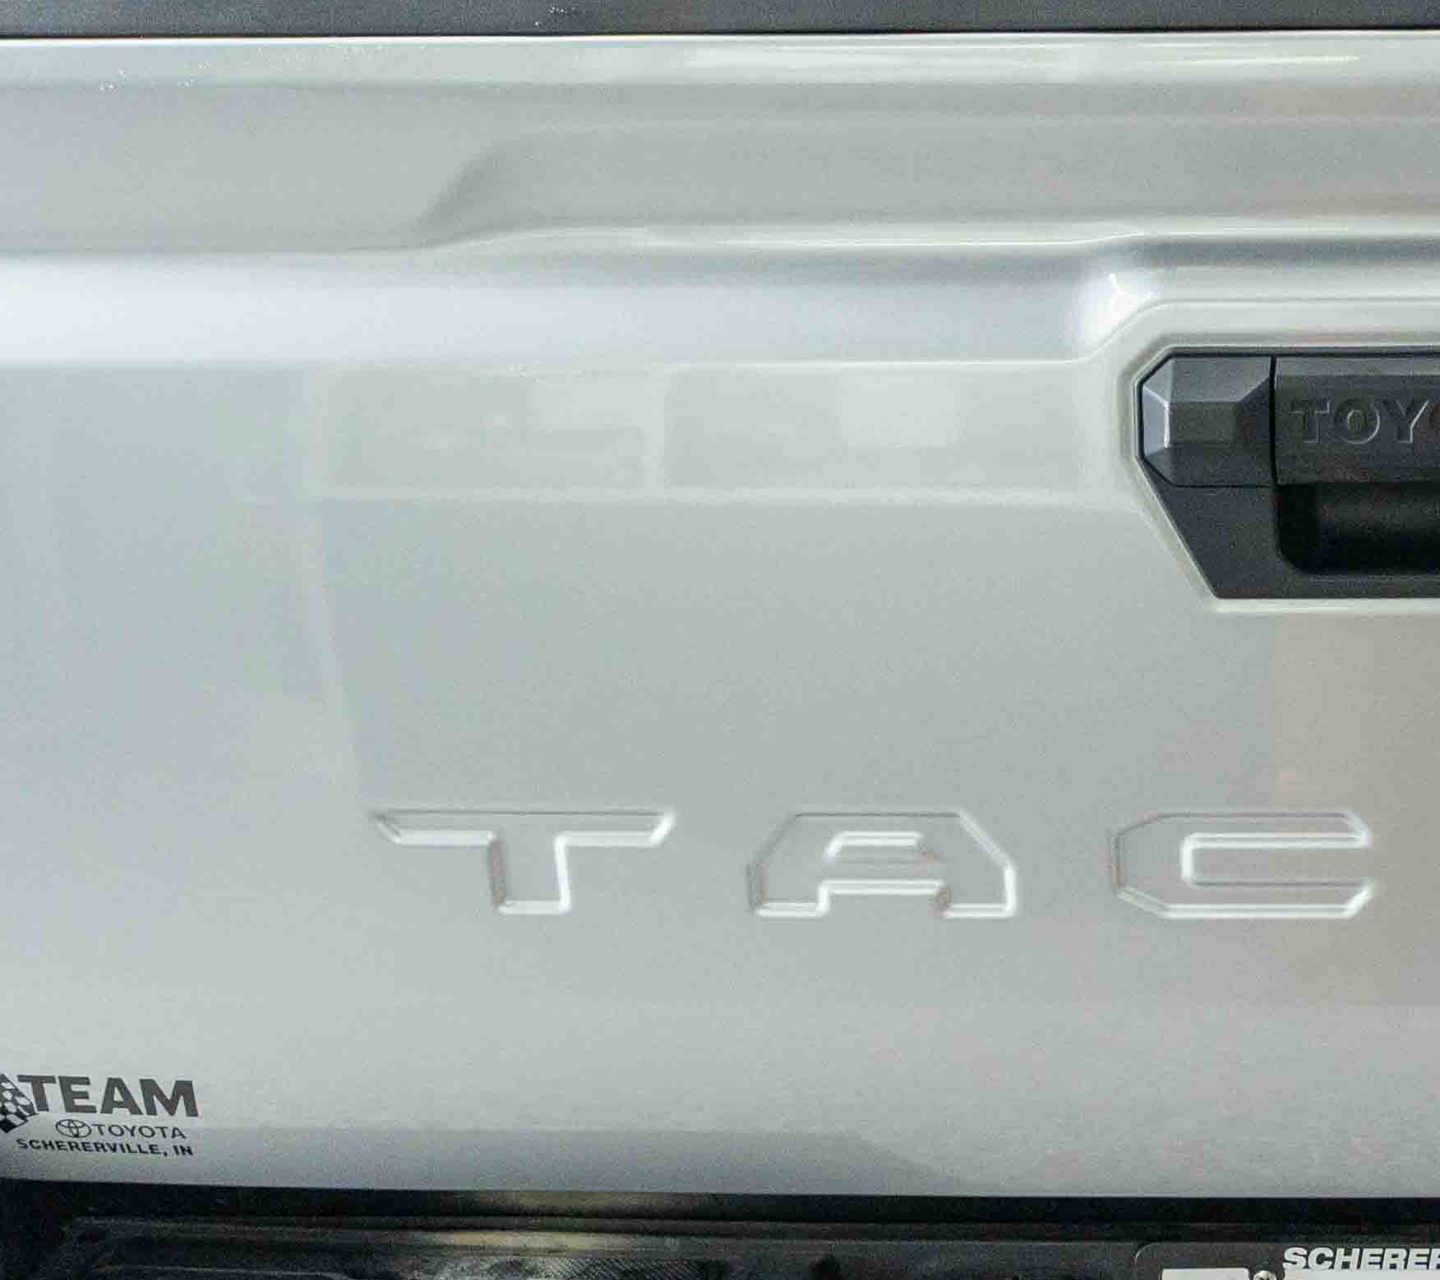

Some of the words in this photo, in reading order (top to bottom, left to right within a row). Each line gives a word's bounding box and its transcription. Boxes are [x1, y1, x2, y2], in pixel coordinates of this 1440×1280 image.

[17, 1074, 199, 1117] TEAM
[92, 1122, 187, 1140] TOYOTA
[15, 1137, 168, 1157] SCHERERVILLE,
[173, 1144, 194, 1157] IN
